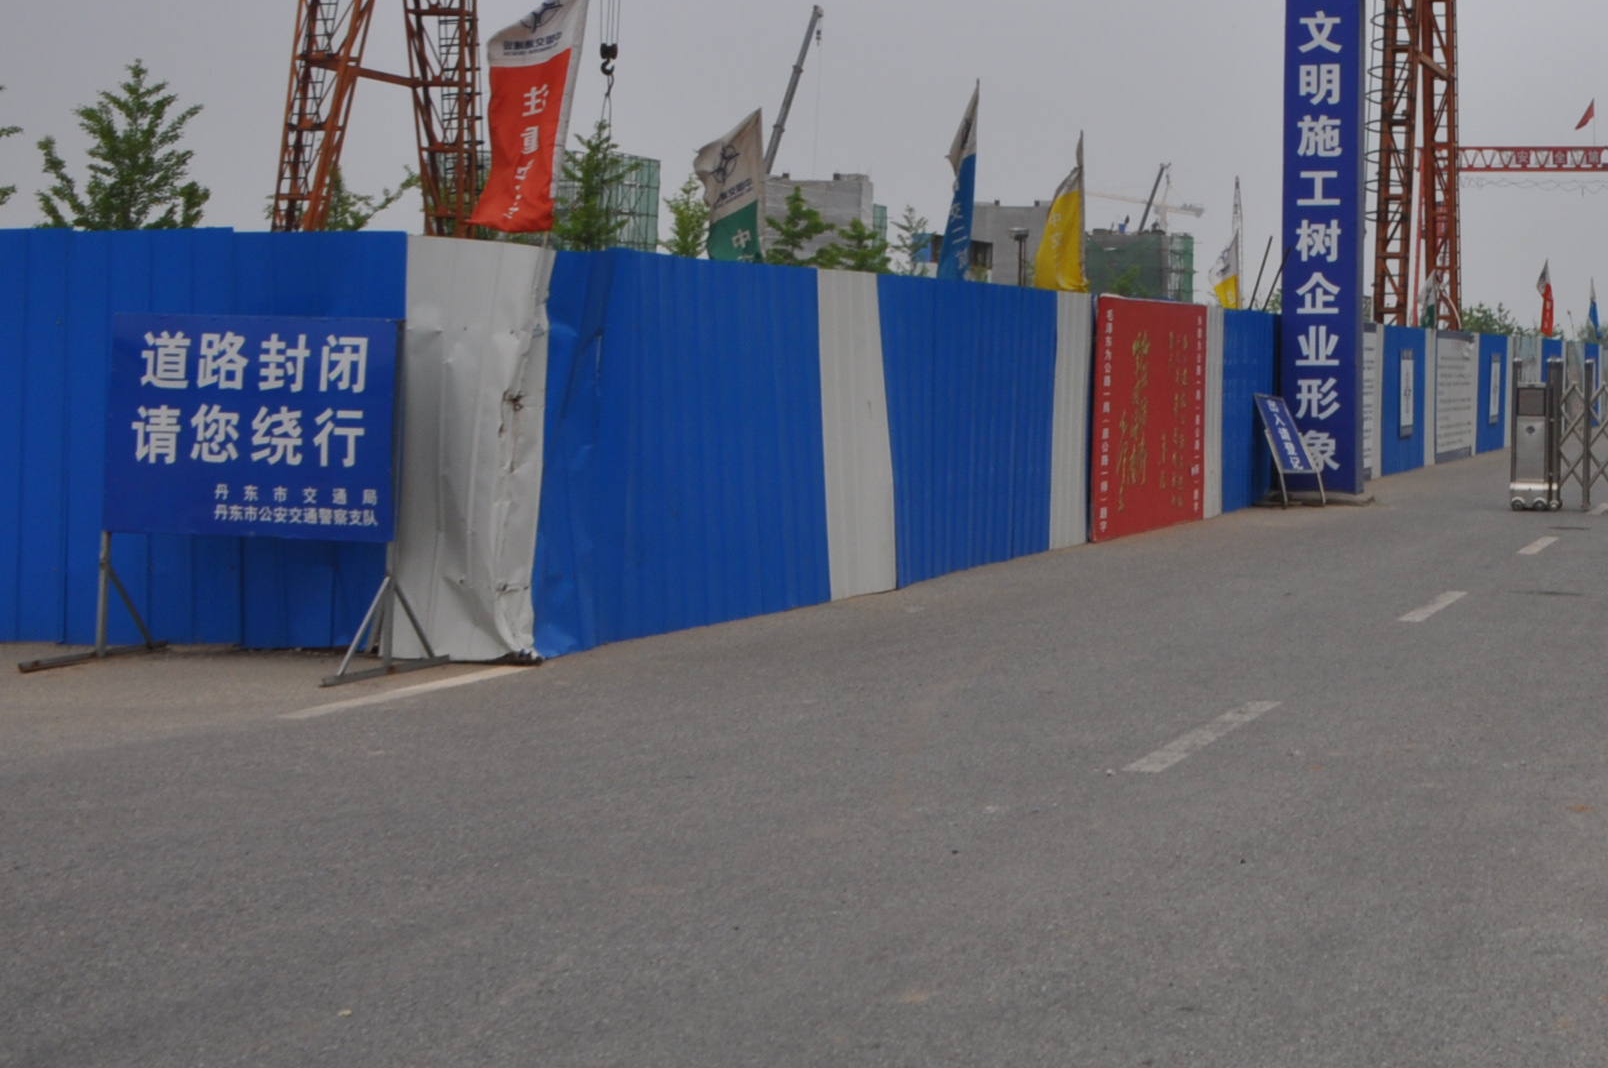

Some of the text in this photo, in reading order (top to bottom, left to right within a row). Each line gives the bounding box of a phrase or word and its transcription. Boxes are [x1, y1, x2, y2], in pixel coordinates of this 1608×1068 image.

[1294, 10, 1342, 471] 文明施工树企业形象
[140, 331, 368, 393] 道路封闭
[131, 404, 366, 468] 请您绕行
[1266, 400, 1305, 471] 出入请登记
[213, 503, 379, 527] 丹东市公安交通警察支队
[214, 483, 379, 505] 丹东市交通局
